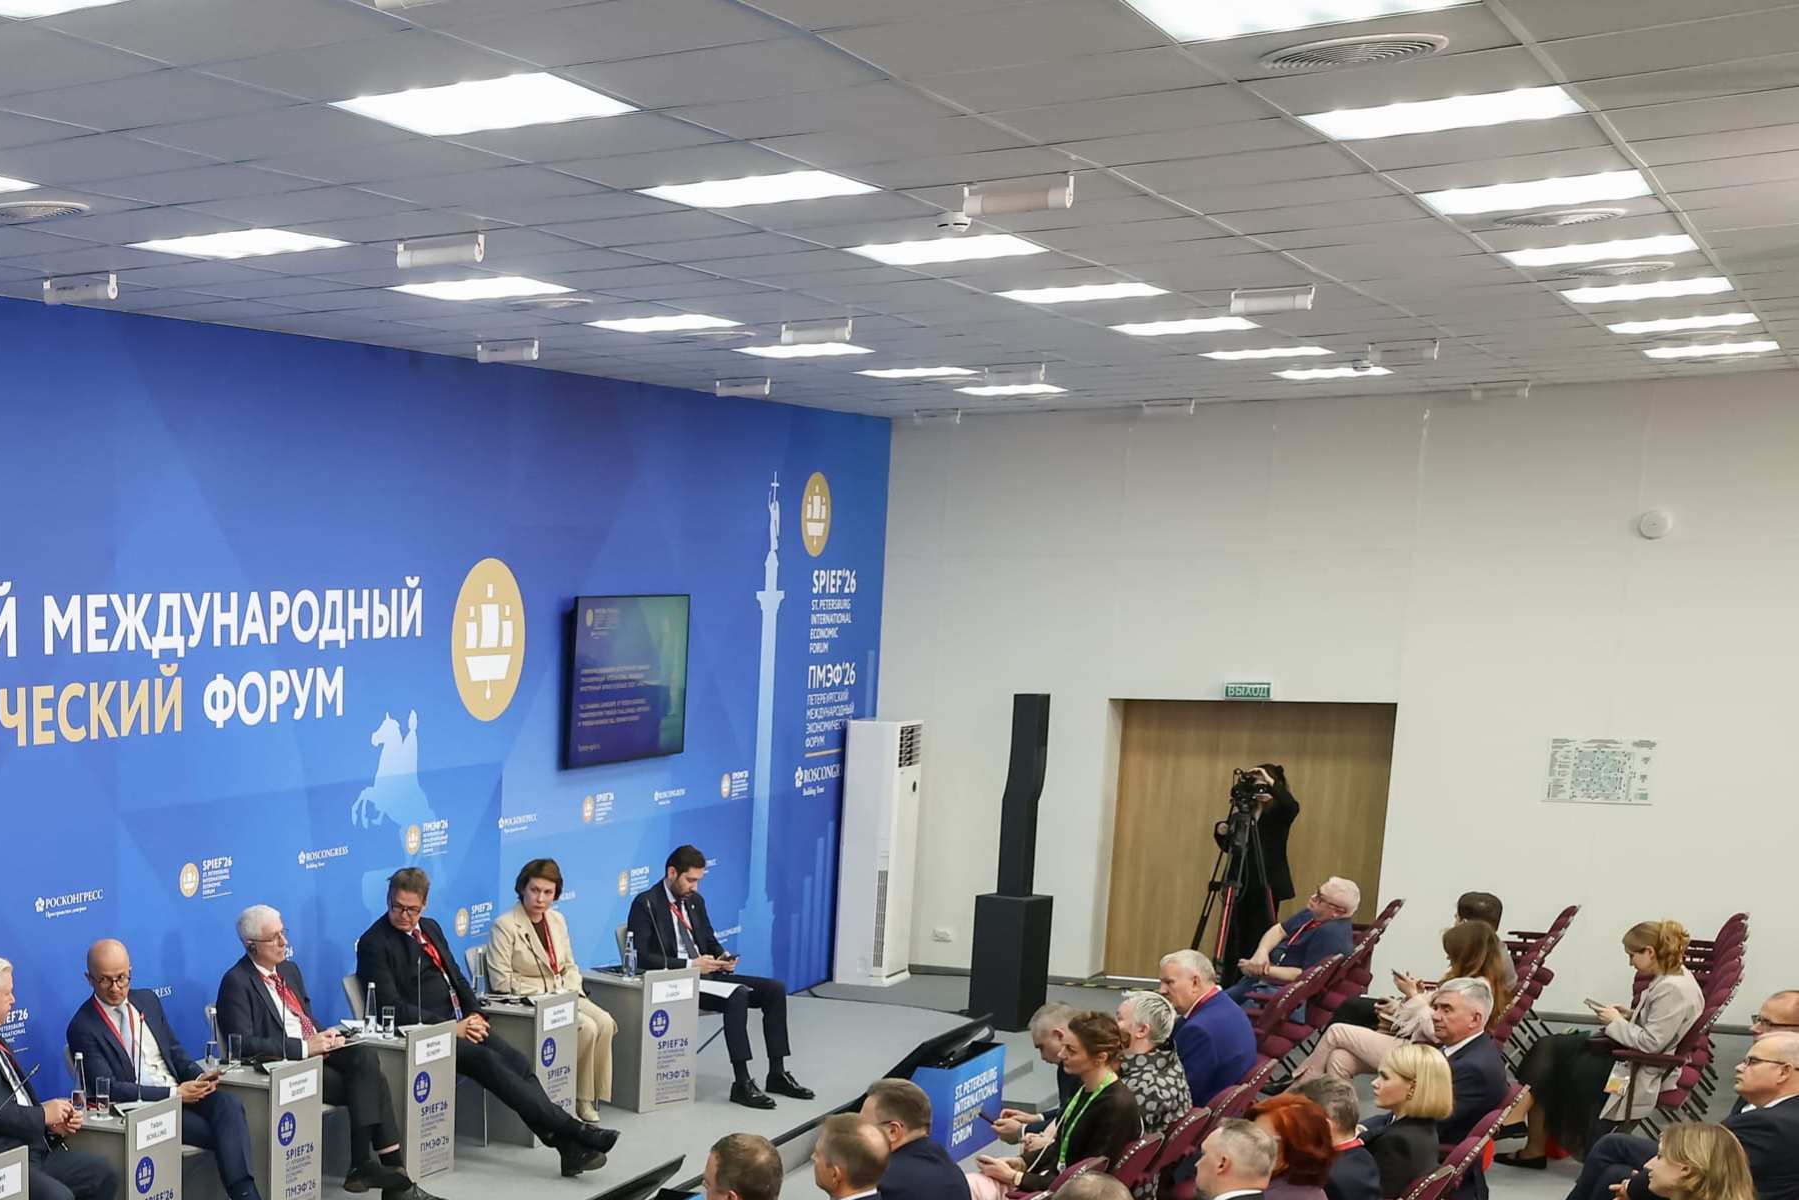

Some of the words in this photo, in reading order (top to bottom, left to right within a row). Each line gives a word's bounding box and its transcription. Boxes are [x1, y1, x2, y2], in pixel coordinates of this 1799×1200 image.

[812, 569, 857, 594] SPIEF'26
[43, 576, 423, 660] МЕЖДУНАРОДНЫЙ
[810, 627, 839, 639] ECONOMIC
[809, 642, 829, 654] FORUM
[808, 662, 856, 689] ПМЭФ'26
[202, 666, 345, 729] ФОРУМ
[1228, 686, 1268, 697] ВЫХОД
[203, 856, 232, 871] SPIEF'26
[45, 889, 104, 909] РОСКОНГРЕСС
[657, 1038, 688, 1050] SPIEF'26
[963, 1067, 998, 1095] PETERSBURG
[421, 1100, 448, 1117] SPIEF'26
[954, 1080, 998, 1116] INTERNATIONAL
[952, 1122, 973, 1147] FORUM
[286, 1142, 314, 1161] SPIEF'26
[286, 1178, 316, 1200] ПМЭФ'26
